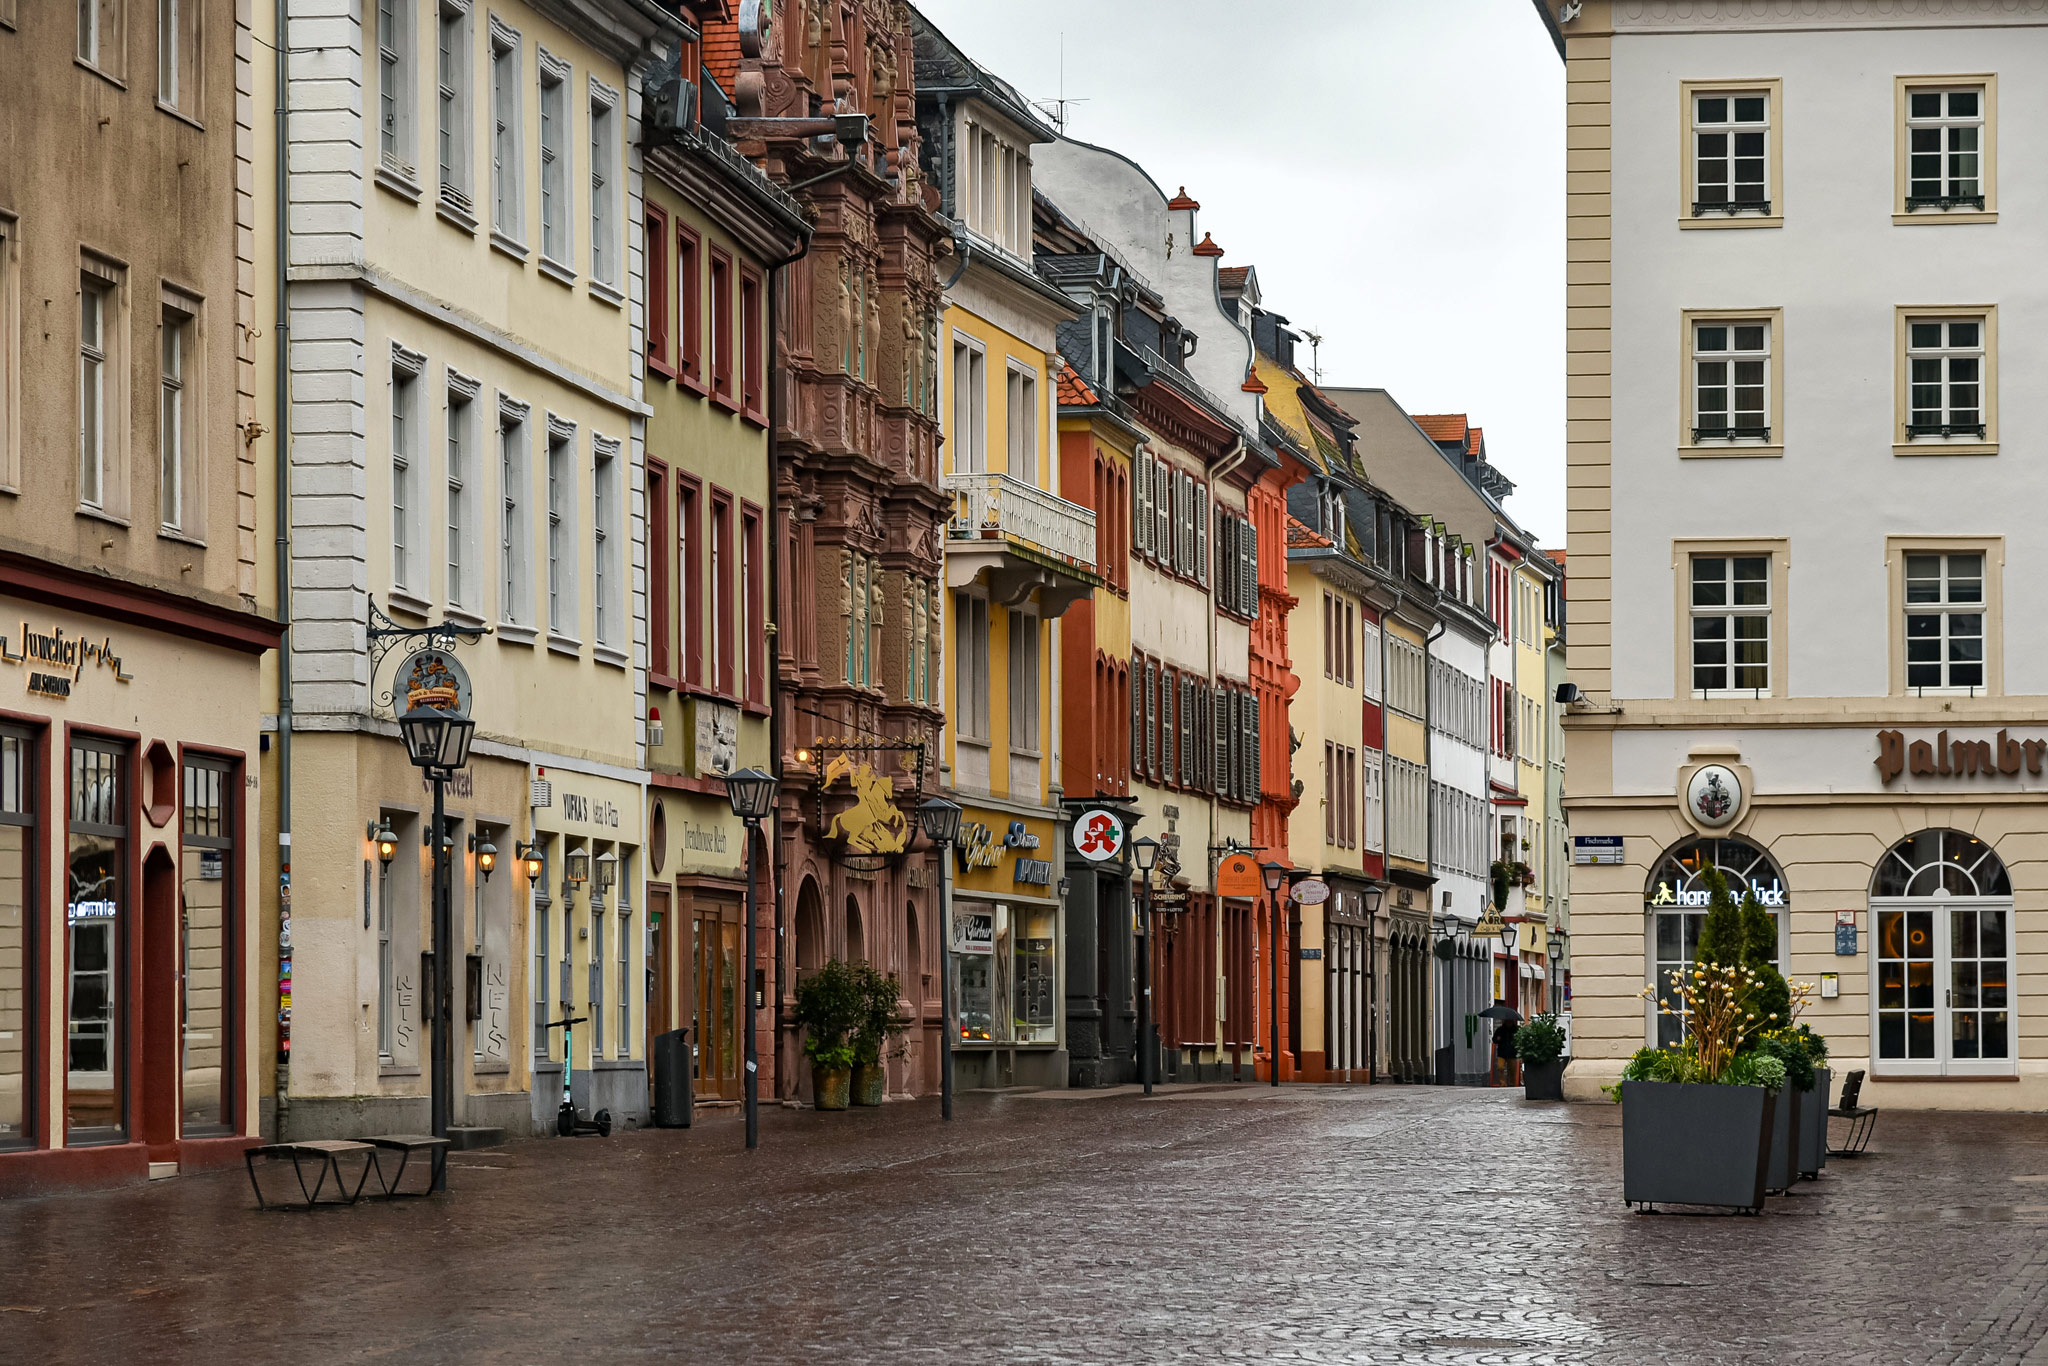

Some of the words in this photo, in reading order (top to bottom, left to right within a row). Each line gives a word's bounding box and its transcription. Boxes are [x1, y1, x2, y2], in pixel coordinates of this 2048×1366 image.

[20, 621, 78, 666] Juwelier
[562, 793, 588, 822] YUFKA'S
[1153, 893, 1186, 901] SCHEURING
